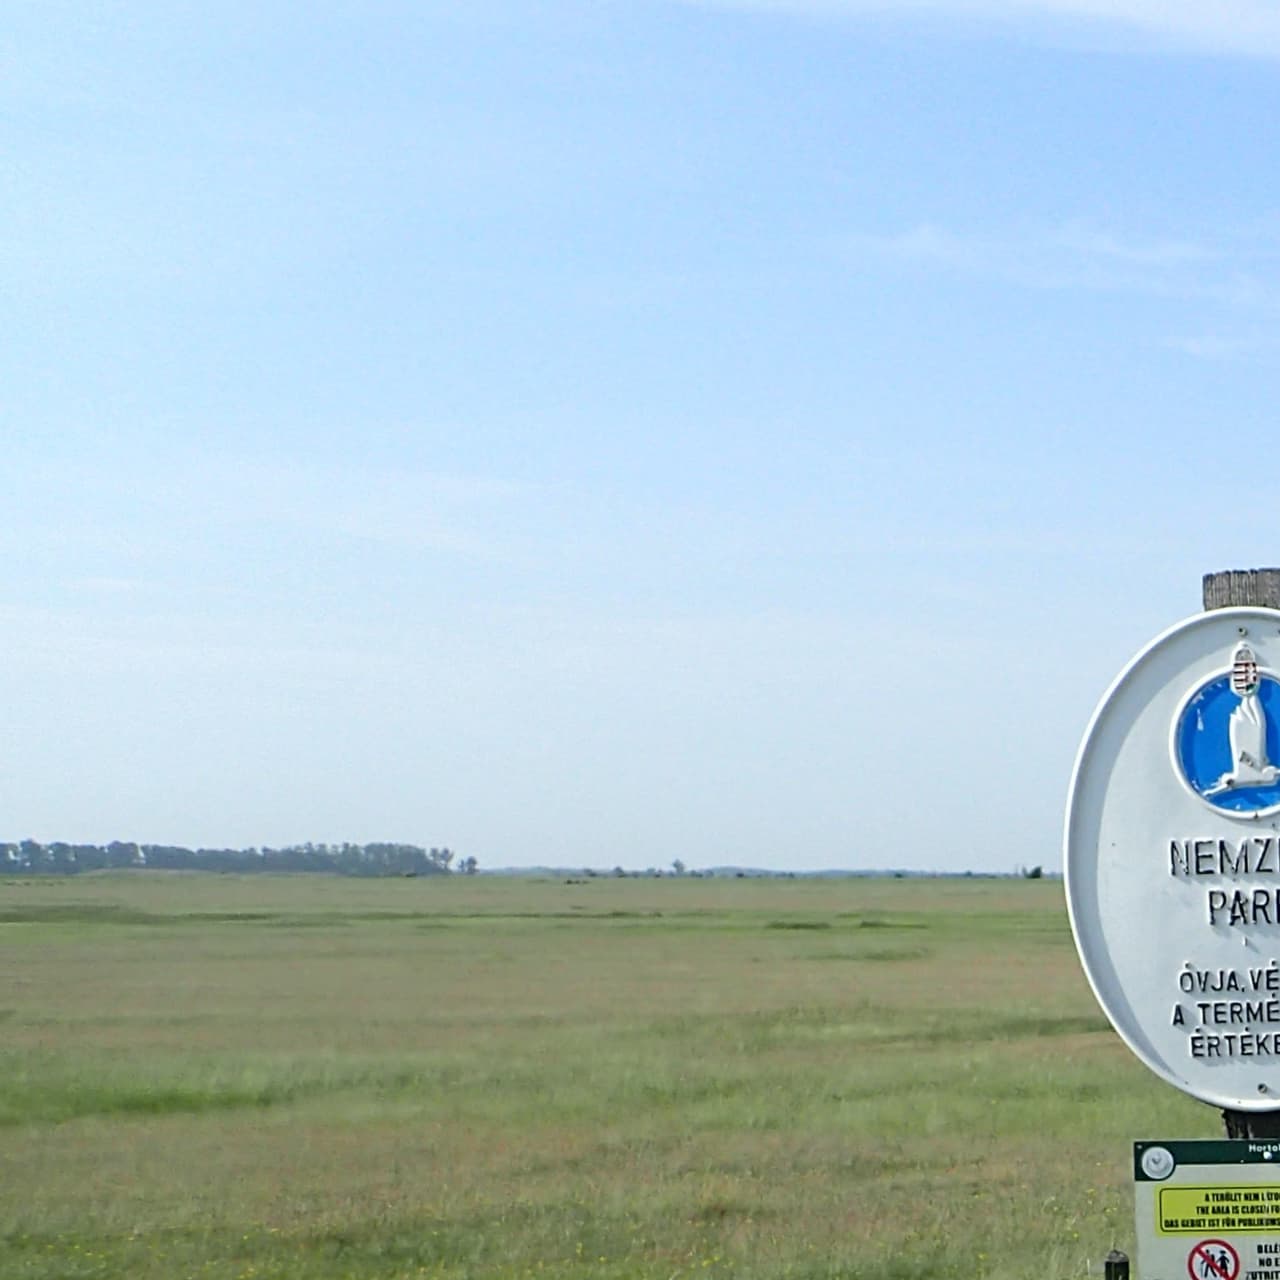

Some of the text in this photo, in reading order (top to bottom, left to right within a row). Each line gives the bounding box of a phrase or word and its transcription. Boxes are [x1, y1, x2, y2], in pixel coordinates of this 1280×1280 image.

[1172, 1004, 1185, 1026] A
[1205, 1193, 1210, 1202] A
[1231, 1205, 1239, 1214] IS
[1208, 1218, 1220, 1227] IST
[1258, 1257, 1272, 1267] NO
